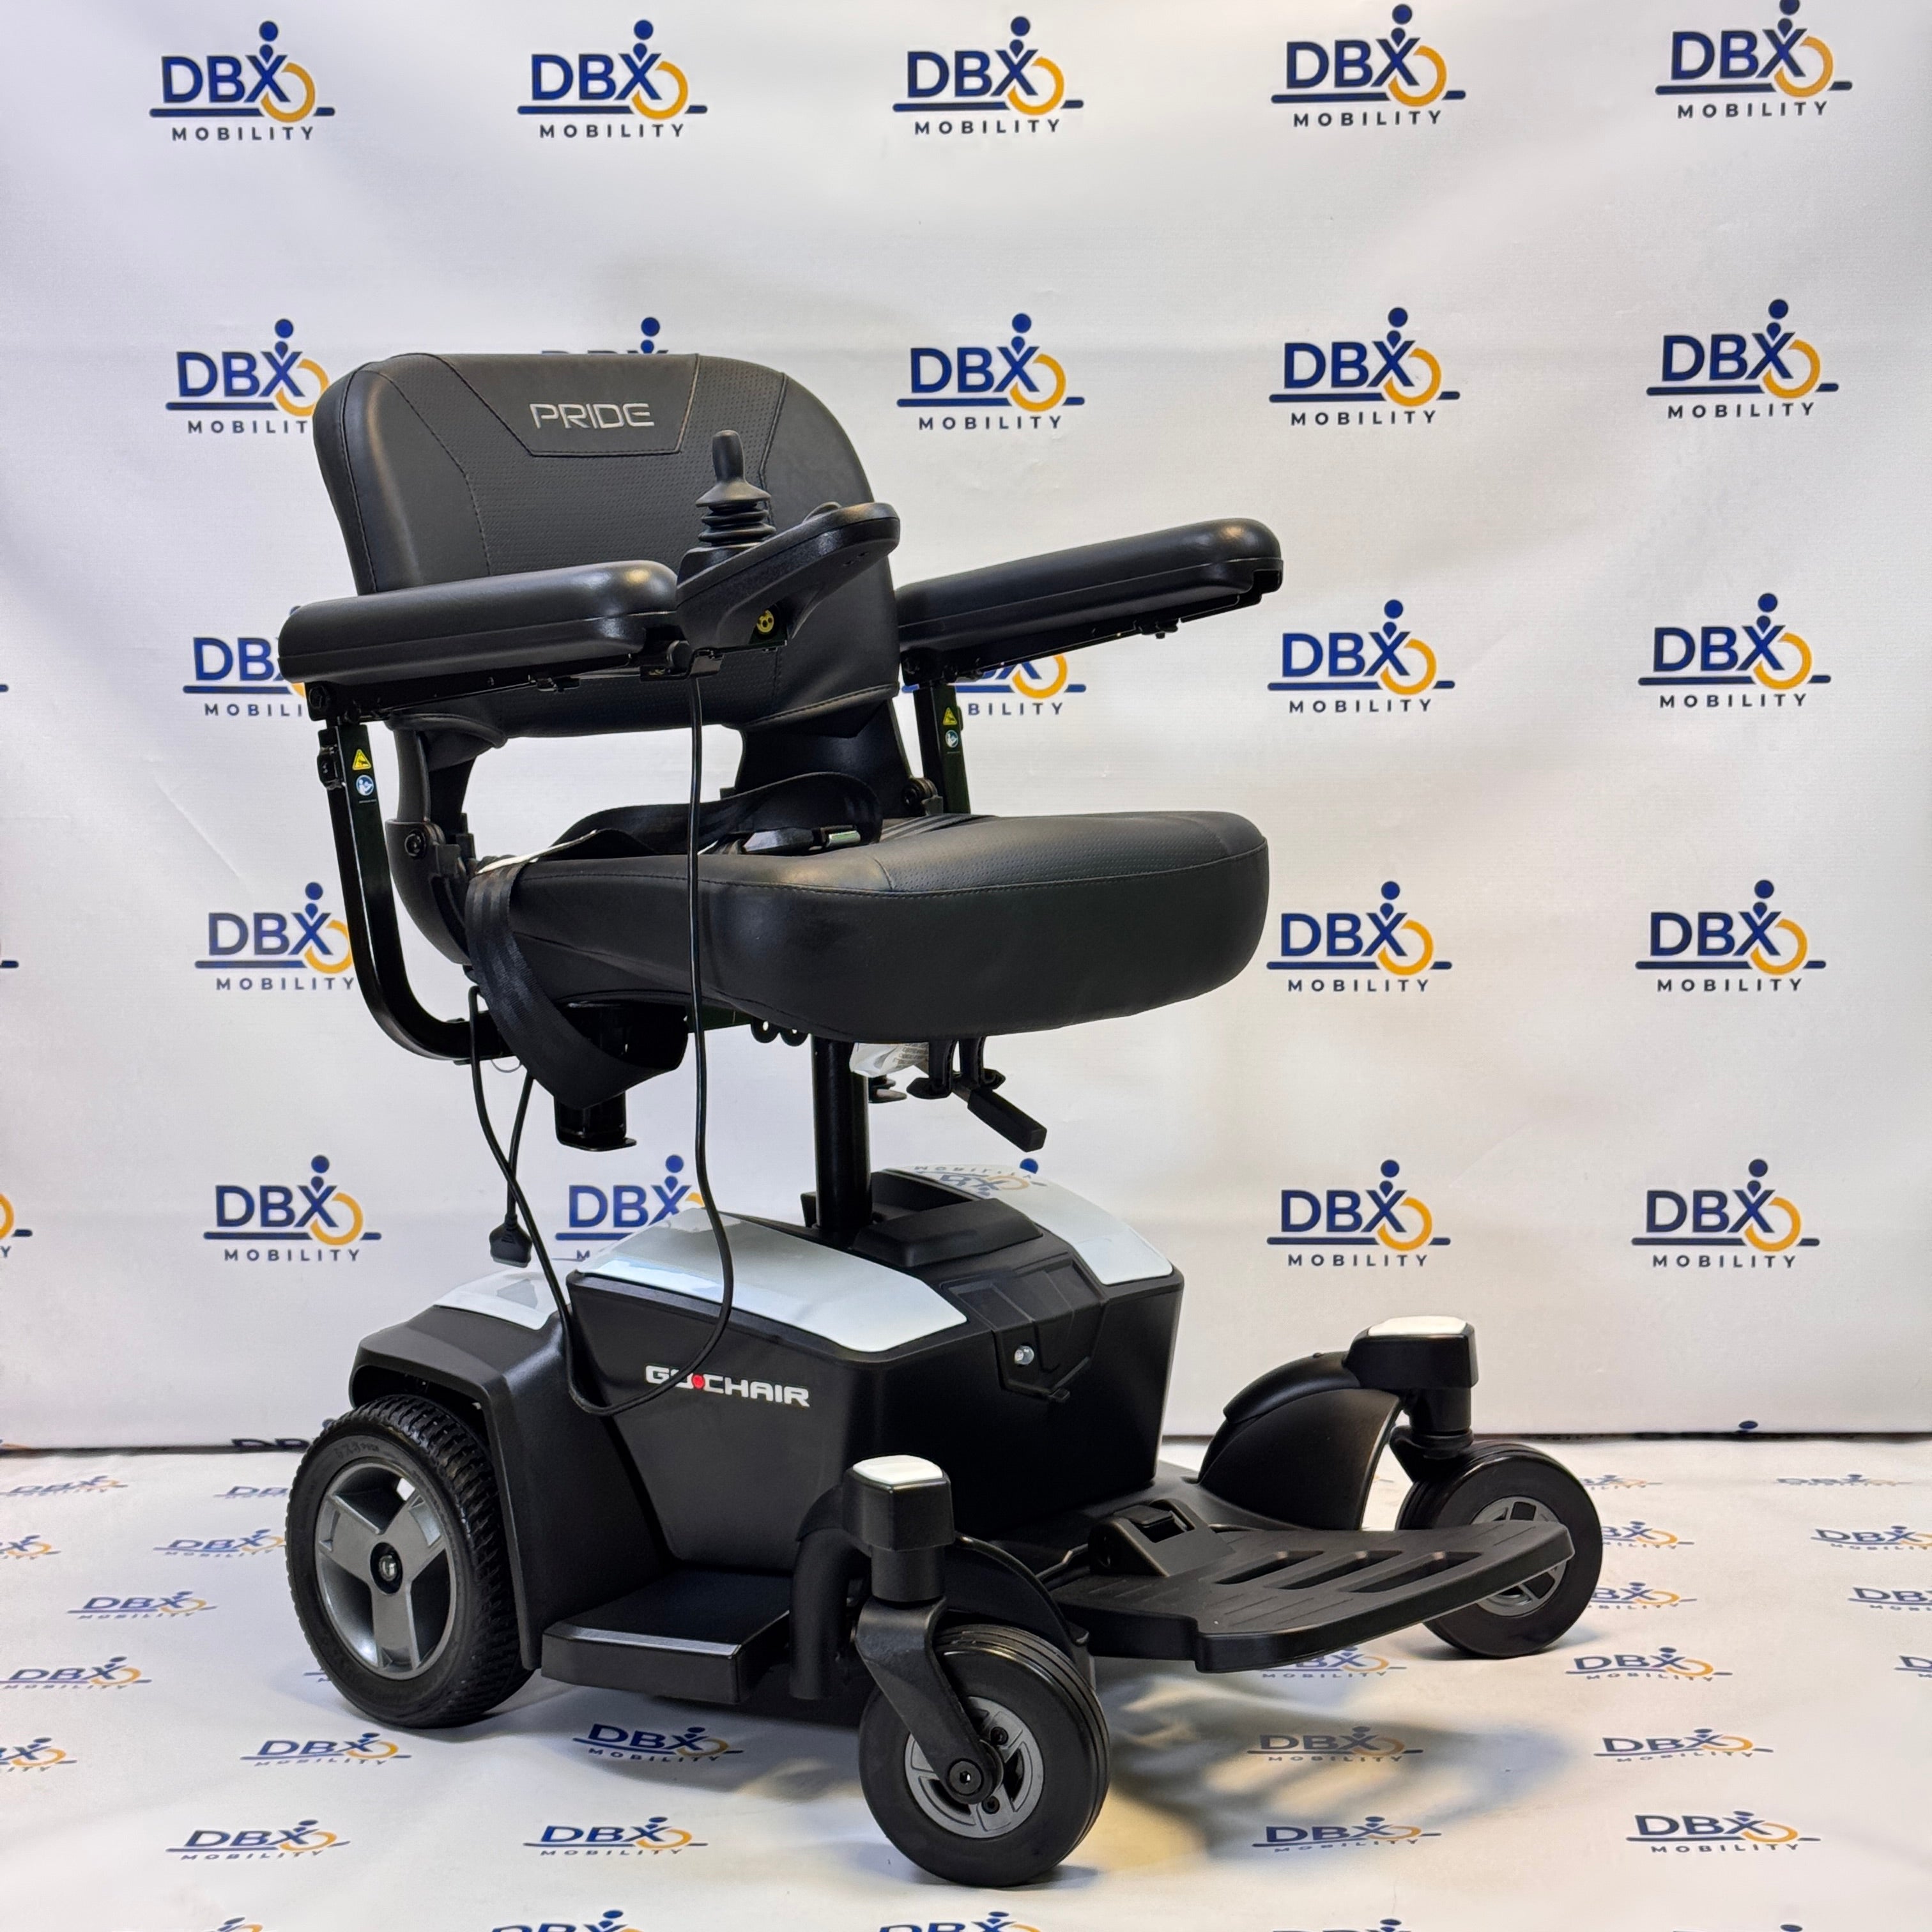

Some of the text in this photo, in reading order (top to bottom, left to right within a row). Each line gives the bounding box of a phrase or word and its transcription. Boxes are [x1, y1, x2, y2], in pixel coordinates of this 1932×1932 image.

[1286, 37, 1421, 89] DBX
[1671, 27, 1807, 81] DBX
[161, 54, 291, 104] DBX
[531, 52, 663, 102] DBX
[907, 49, 1039, 99] DBX
[1293, 109, 1441, 128] MOBILITY
[1677, 101, 1827, 119] MOBILITY
[172, 126, 313, 141] MOBILITY
[539, 123, 684, 139] MOBILITY
[914, 118, 1060, 135] MOBILITY
[1284, 339, 1416, 390] DBX
[1661, 332, 1796, 382] DBX
[176, 351, 305, 397] DBX
[910, 346, 1040, 394] DBX
[529, 402, 655, 429] PRIDE
[1291, 410, 1436, 426] MOBILITY
[1667, 402, 1814, 419] MOBILITY
[188, 420, 307, 434] MOBILIT
[919, 415, 1061, 431] MOBILITY
[1282, 631, 1411, 678] DBX
[1653, 624, 1786, 673] DBX
[193, 637, 284, 681] DB
[204, 703, 302, 716] MOBILI
[968, 702, 1064, 716] BILITY
[1289, 698, 1431, 714] MOBILITY
[1660, 693, 1806, 709] MOBILITY
[208, 912, 334, 956] DBX
[1280, 912, 1408, 957] DBX
[1650, 910, 1782, 957] DBX
[216, 977, 355, 990] MOBILITY
[1287, 979, 1429, 992] MOBILITY
[1657, 978, 1802, 992] MOBILITY
[215, 1184, 339, 1228] DBX
[569, 1184, 692, 1228] DBX
[1280, 1189, 1407, 1233] DBX
[1646, 1189, 1775, 1234] DBX
[224, 1249, 359, 1262] MOBILITY
[1287, 1254, 1427, 1267] MOBILITY
[1653, 1255, 1795, 1269] MOBILITY
[83, 1597, 192, 1609] DBX
[1853, 1587, 1929, 1602] DB
[1574, 1654, 1691, 1670] DBX
[9, 1664, 126, 1680] DBX
[588, 1724, 709, 1751] DBX
[1259, 1734, 1381, 1751] DBX
[1602, 1734, 1728, 1752] DBX
[257, 1739, 381, 1756] DBX
[540, 1825, 672, 1843] DBX
[1266, 1823, 1395, 1843] DBX
[1635, 1814, 1773, 1836] DBX
[185, 1828, 319, 1847] DBX
[1651, 1844, 1799, 1853] MOBILITY
